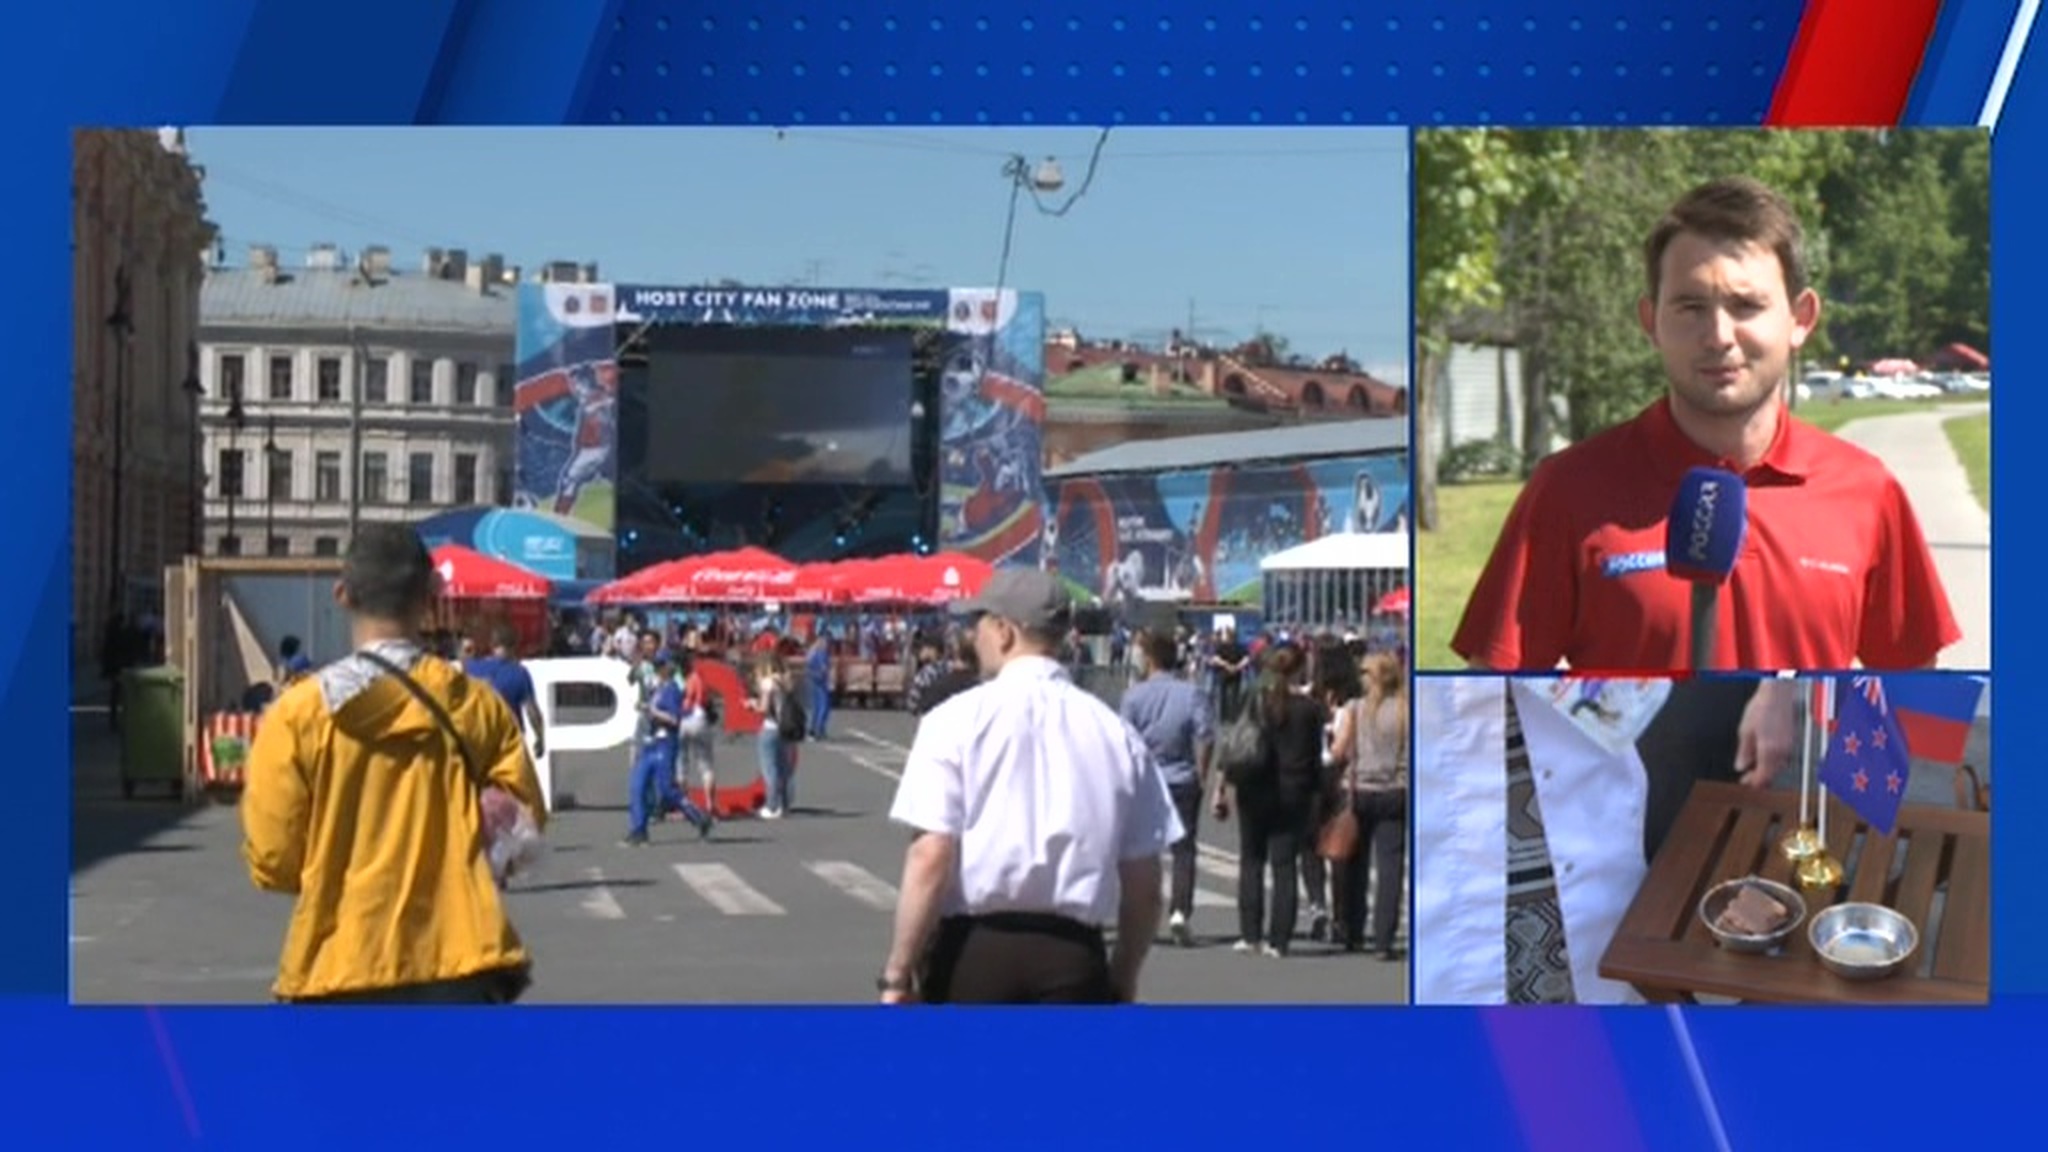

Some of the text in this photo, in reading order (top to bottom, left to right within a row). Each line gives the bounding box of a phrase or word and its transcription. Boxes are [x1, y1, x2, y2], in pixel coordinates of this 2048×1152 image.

[635, 290, 687, 307] HOST
[692, 290, 738, 307] CITY
[742, 290, 781, 308] FAN
[786, 291, 839, 309] ZONE
